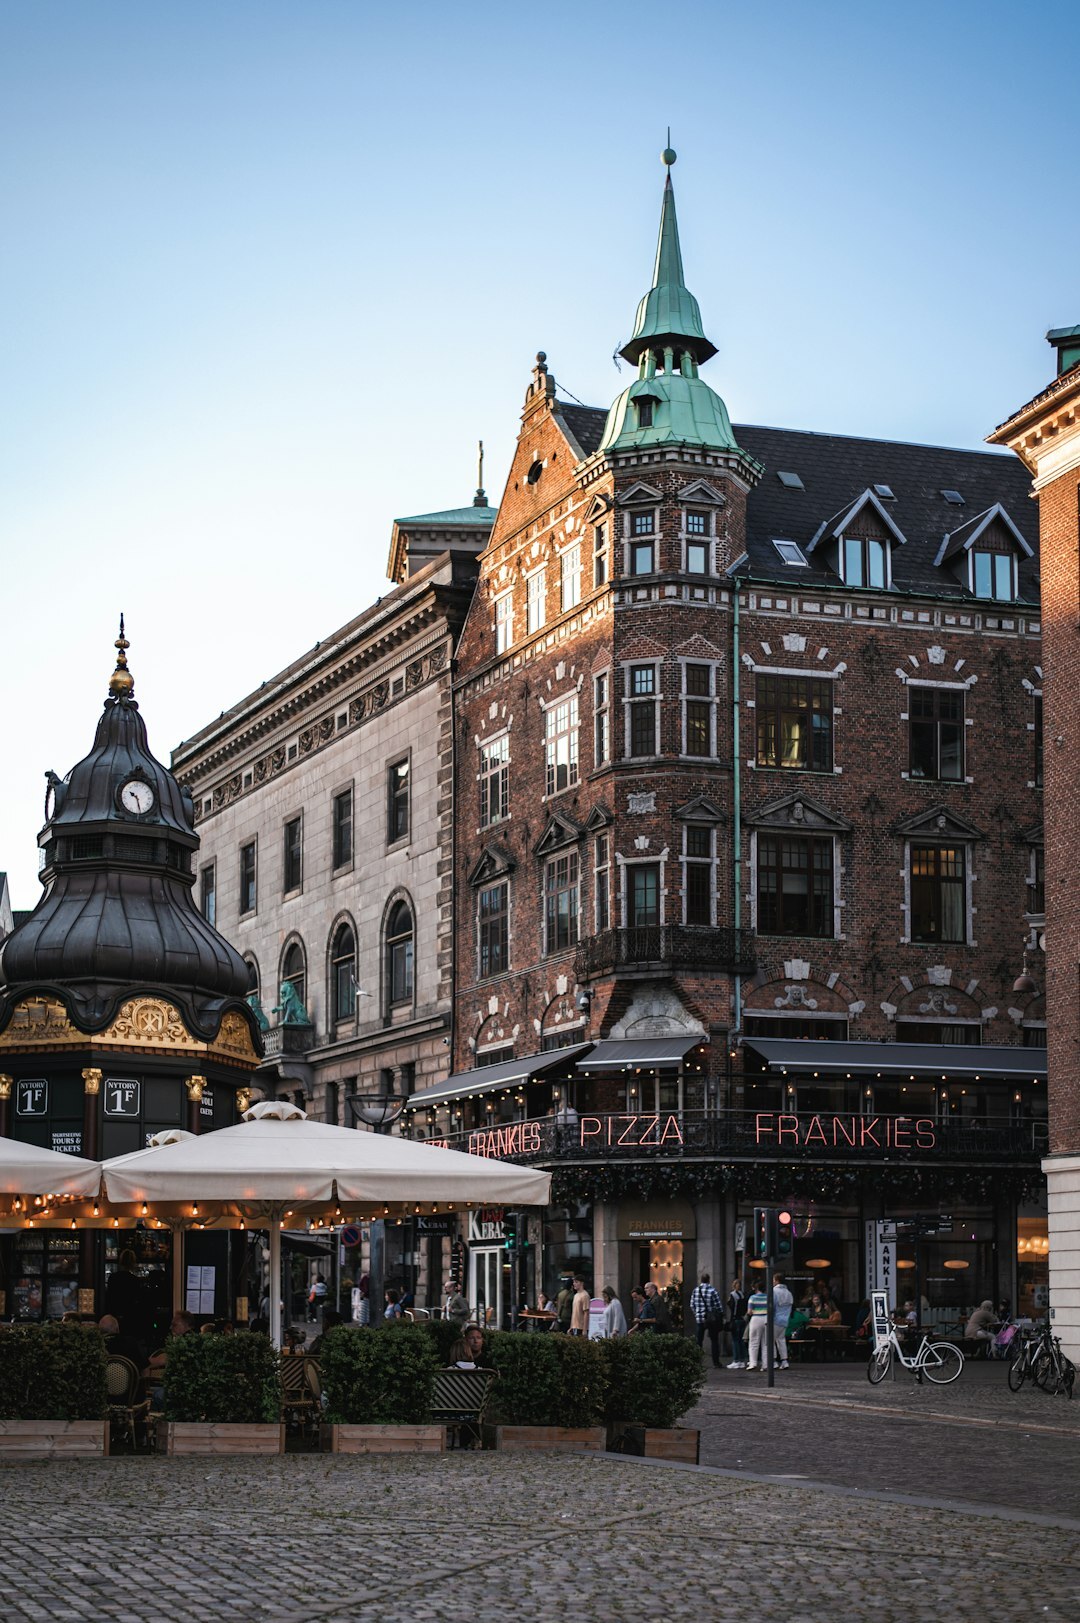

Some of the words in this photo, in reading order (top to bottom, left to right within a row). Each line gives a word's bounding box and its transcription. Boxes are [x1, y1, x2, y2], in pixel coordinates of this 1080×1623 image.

[468, 1122, 541, 1158] FRANKIES
[580, 1115, 684, 1147] PIZZA
[755, 1114, 936, 1148] FRANKIES
[628, 1219, 683, 1230] FRANKIES
